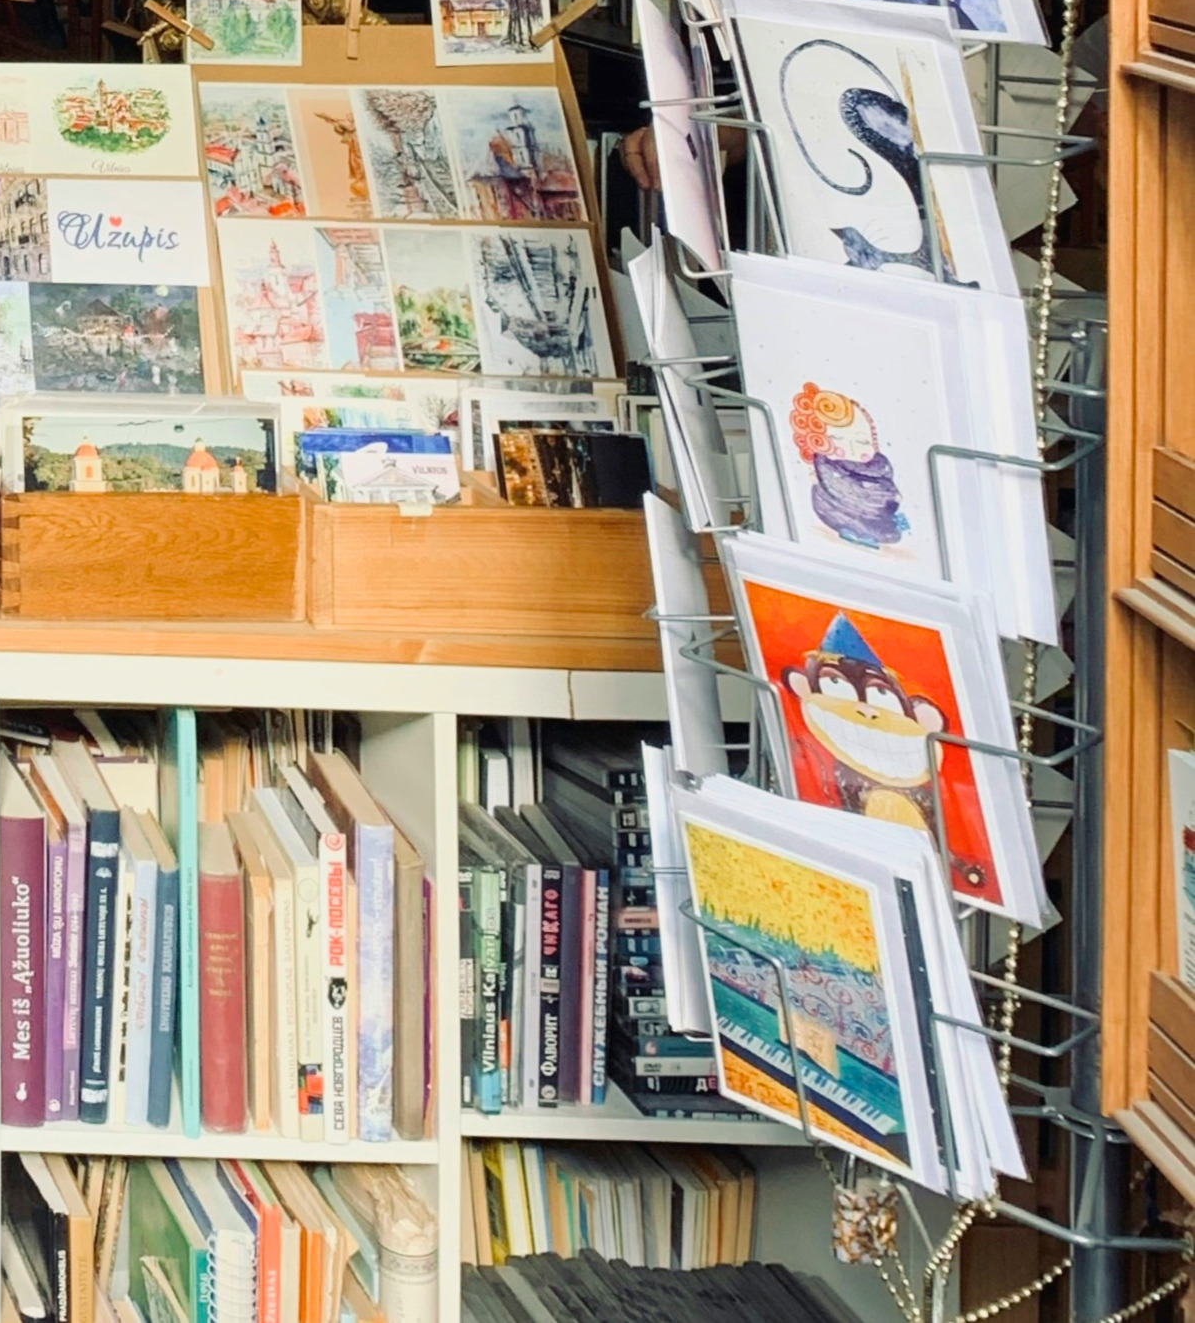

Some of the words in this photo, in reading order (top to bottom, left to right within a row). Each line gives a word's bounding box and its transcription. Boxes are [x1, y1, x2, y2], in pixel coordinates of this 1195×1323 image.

[327, 862, 345, 966] РОК-ПОСЕВЫ
[542, 889, 561, 956] ЧИКАГО
[594, 885, 609, 954] РОМАН
[482, 908, 499, 996] Kalvarijos
[11, 998, 31, 1016] iš
[12, 1021, 31, 1060] Mes
[481, 1002, 497, 1073] Vilniaus
[593, 958, 607, 1087] СЛУЖЕБНЫЙ
[332, 1016, 346, 1097] НОВГОРОДЦЕВ
[334, 1100, 345, 1130] СЕВА
